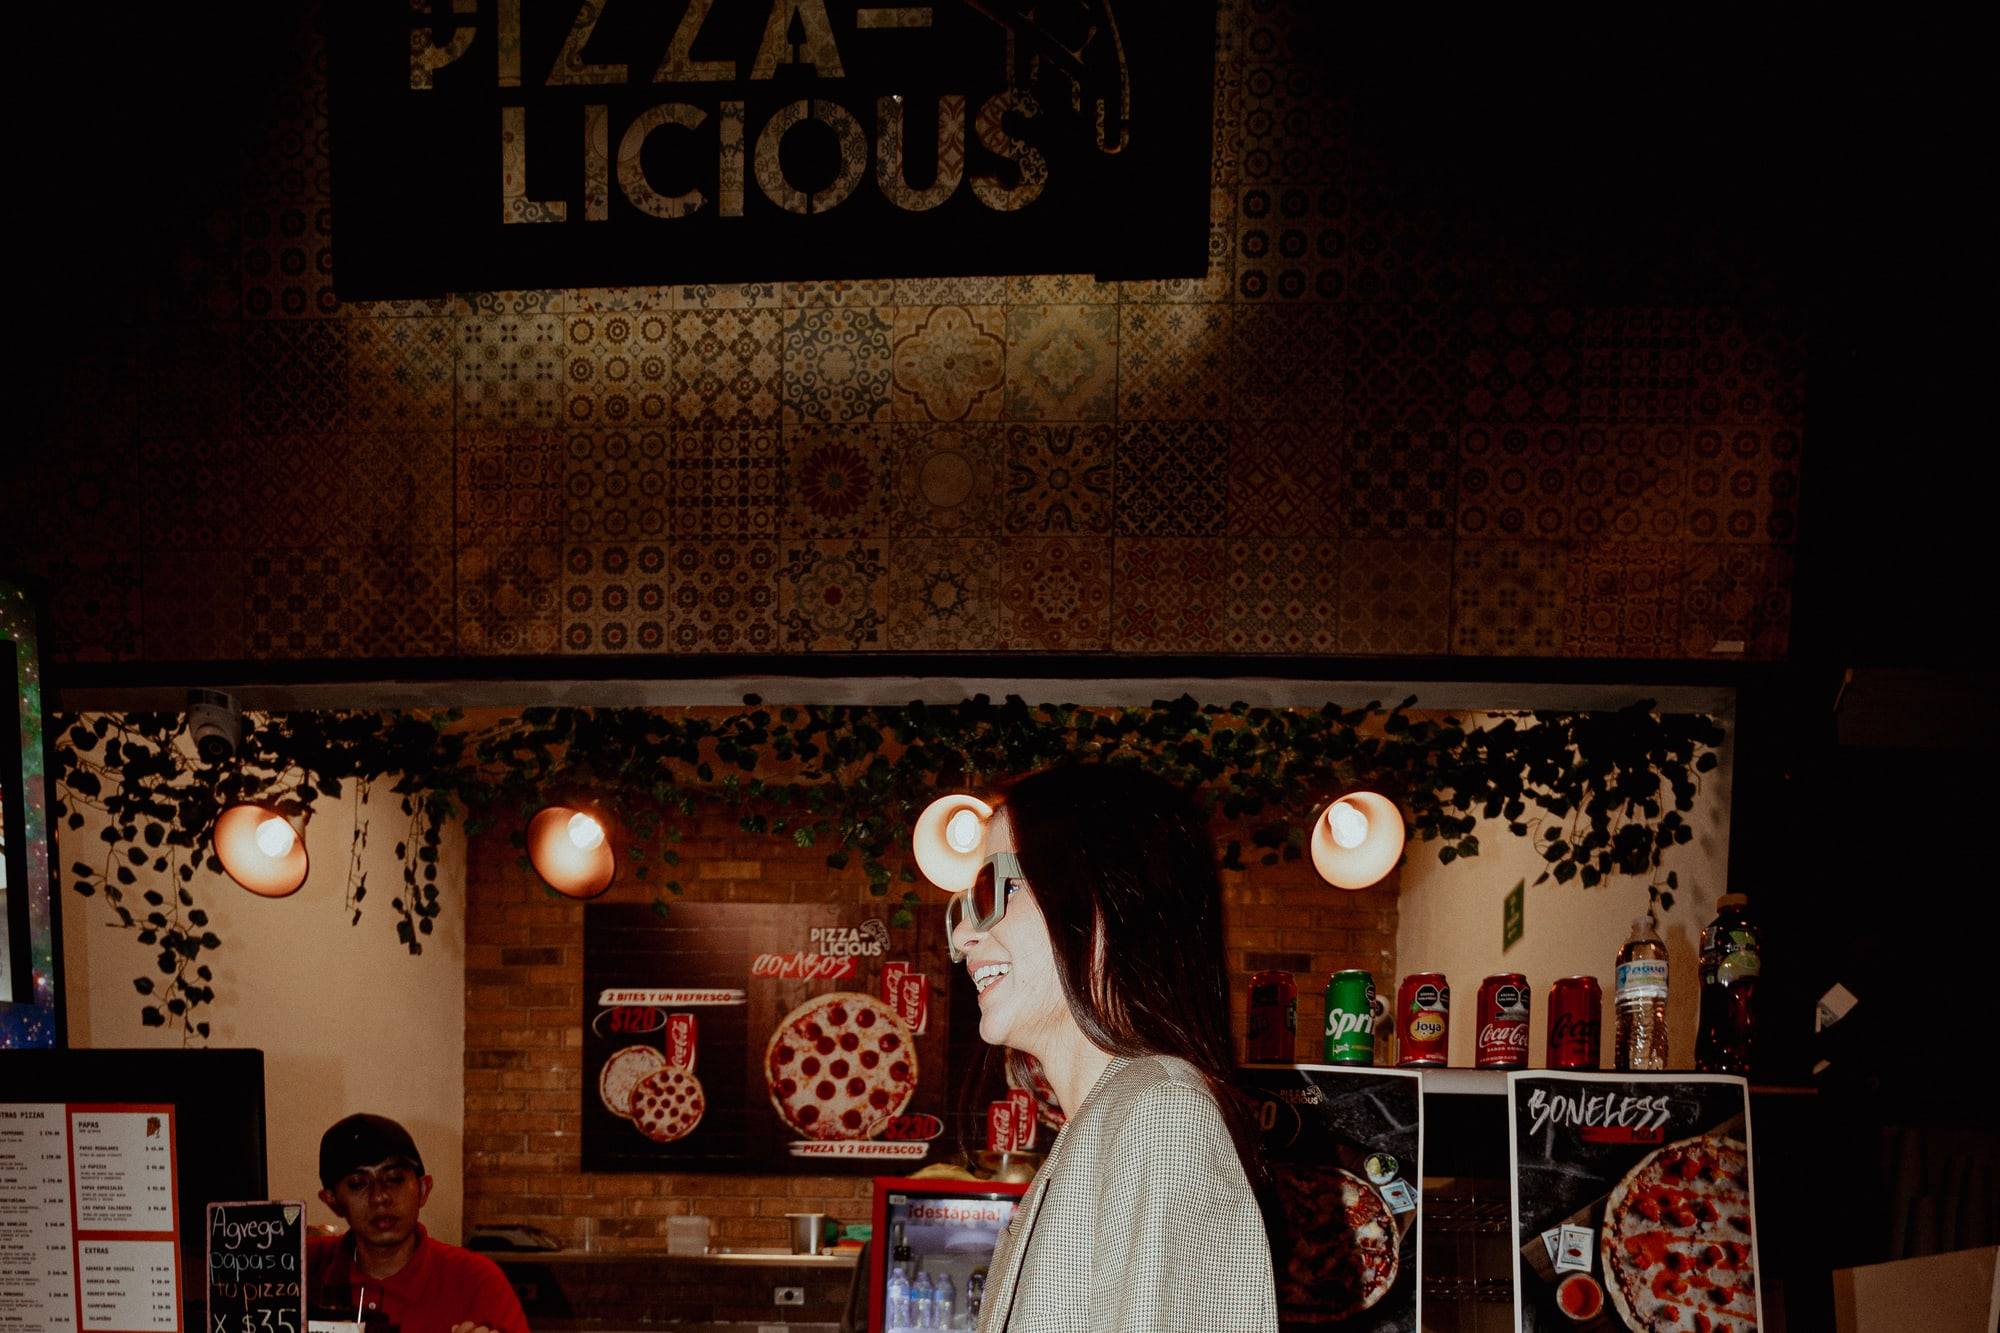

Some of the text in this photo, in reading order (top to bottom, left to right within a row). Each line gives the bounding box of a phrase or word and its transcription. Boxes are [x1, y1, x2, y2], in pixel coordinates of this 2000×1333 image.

[501, 93, 1048, 224] LICIOUS
[820, 942, 882, 957] LICIOUS
[607, 993, 732, 1001] 2 BITES Y UN REFRESCO
[610, 1006, 657, 1034] $120
[1325, 1008, 1376, 1040] Spri
[1416, 1021, 1442, 1034] Joya
[20, 1111, 45, 1119] PIZZAS
[79, 1121, 99, 1129] PAPAS
[1527, 1088, 1671, 1136] BONELESS
[886, 1114, 937, 1140] $230
[803, 1145, 923, 1154] PIZZA Y 2 REFRESCOS
[213, 1206, 285, 1250] Agrega
[210, 1252, 295, 1285] papas a
[213, 1274, 300, 1312] tu pizza
[241, 1307, 297, 1333] $35
